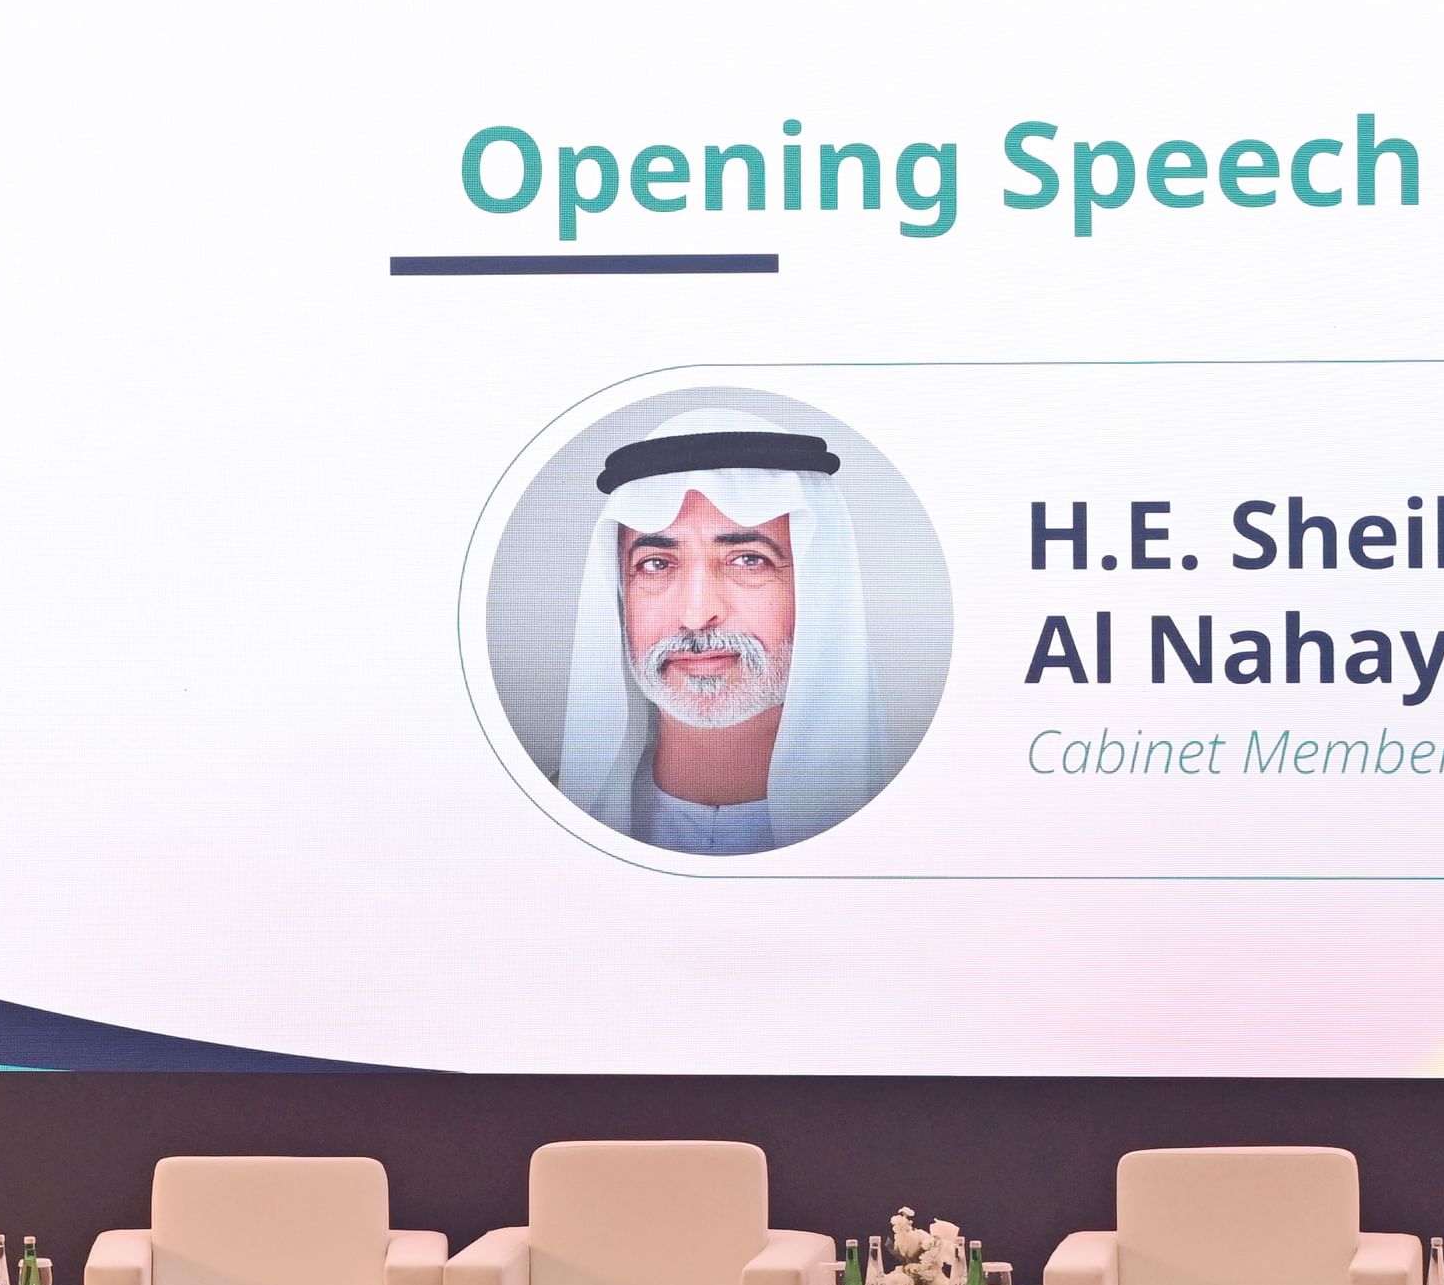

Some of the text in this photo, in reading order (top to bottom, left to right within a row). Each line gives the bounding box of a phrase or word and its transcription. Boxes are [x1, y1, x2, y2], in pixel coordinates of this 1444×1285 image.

[460, 112, 1420, 242] Opening Speech
[1030, 500, 1199, 572] H.E.
[1023, 610, 1112, 685] Al
[1028, 726, 1227, 775] Cabinet
